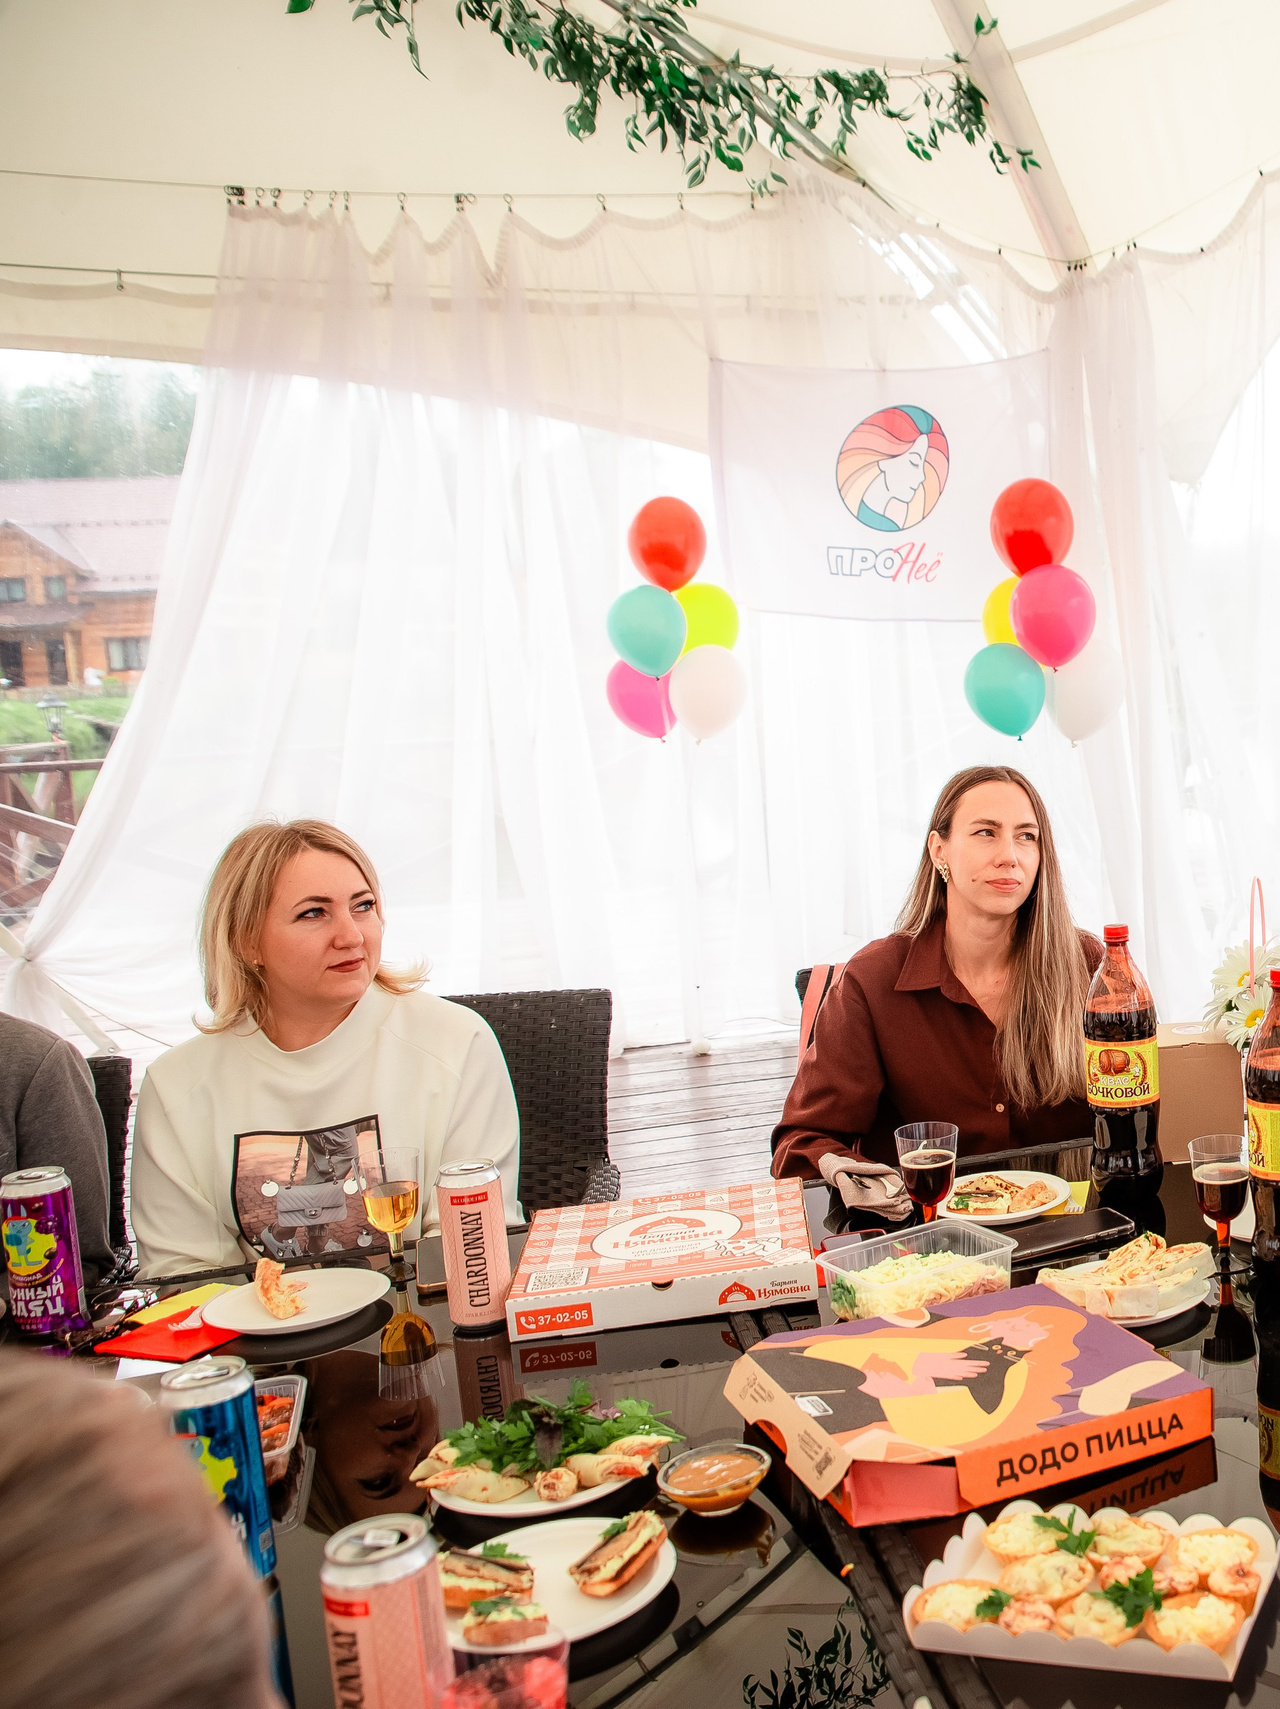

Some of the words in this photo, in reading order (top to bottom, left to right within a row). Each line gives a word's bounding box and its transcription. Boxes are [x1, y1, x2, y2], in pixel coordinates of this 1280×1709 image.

[1099, 1075, 1131, 1087] КВАС
[1087, 1081, 1151, 1100] БОЧКОВОЙ
[651, 1191, 702, 1204] 37-02-05
[459, 1210, 491, 1308] CHARDONNAY
[756, 1283, 812, 1300] Нямовна
[769, 1278, 799, 1289] Барыня
[464, 1308, 499, 1319] SPARKLING
[537, 1310, 589, 1326] 37-02-05
[996, 1441, 1080, 1488] ДОДО
[1084, 1413, 1184, 1457] ПИЦЦА
